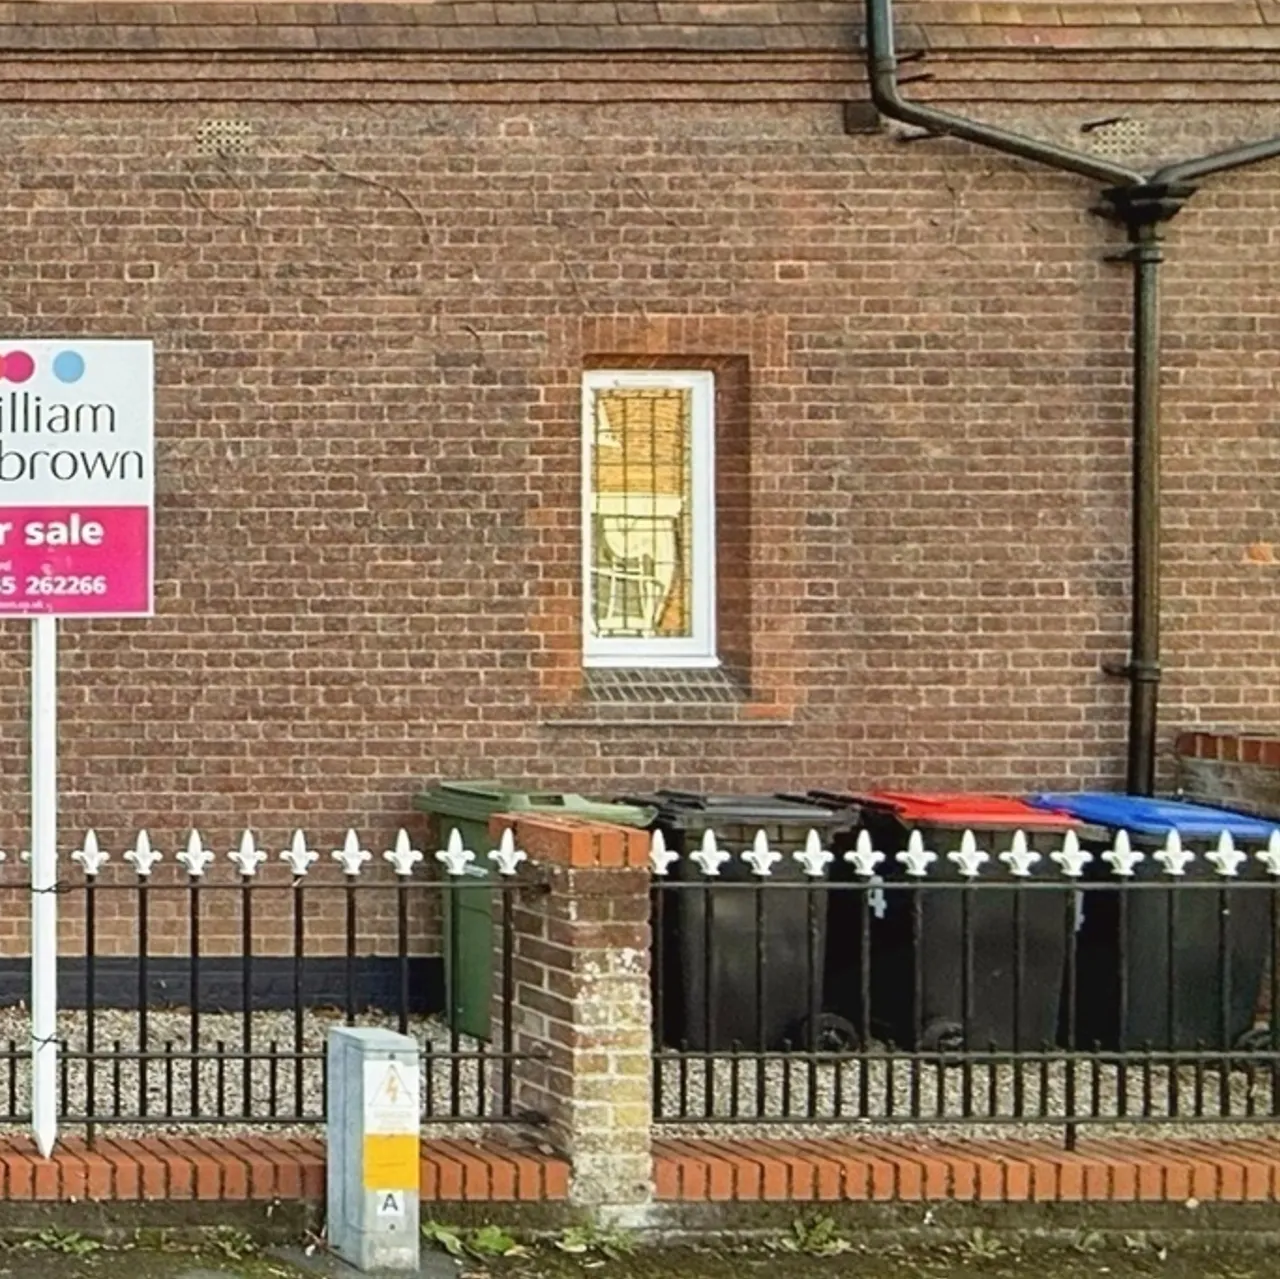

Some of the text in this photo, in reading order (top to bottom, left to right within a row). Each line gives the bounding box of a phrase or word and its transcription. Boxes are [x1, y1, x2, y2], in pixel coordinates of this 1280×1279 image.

[24, 512, 104, 546] sale
[25, 575, 108, 595] 262266
[382, 1193, 399, 1212] A
